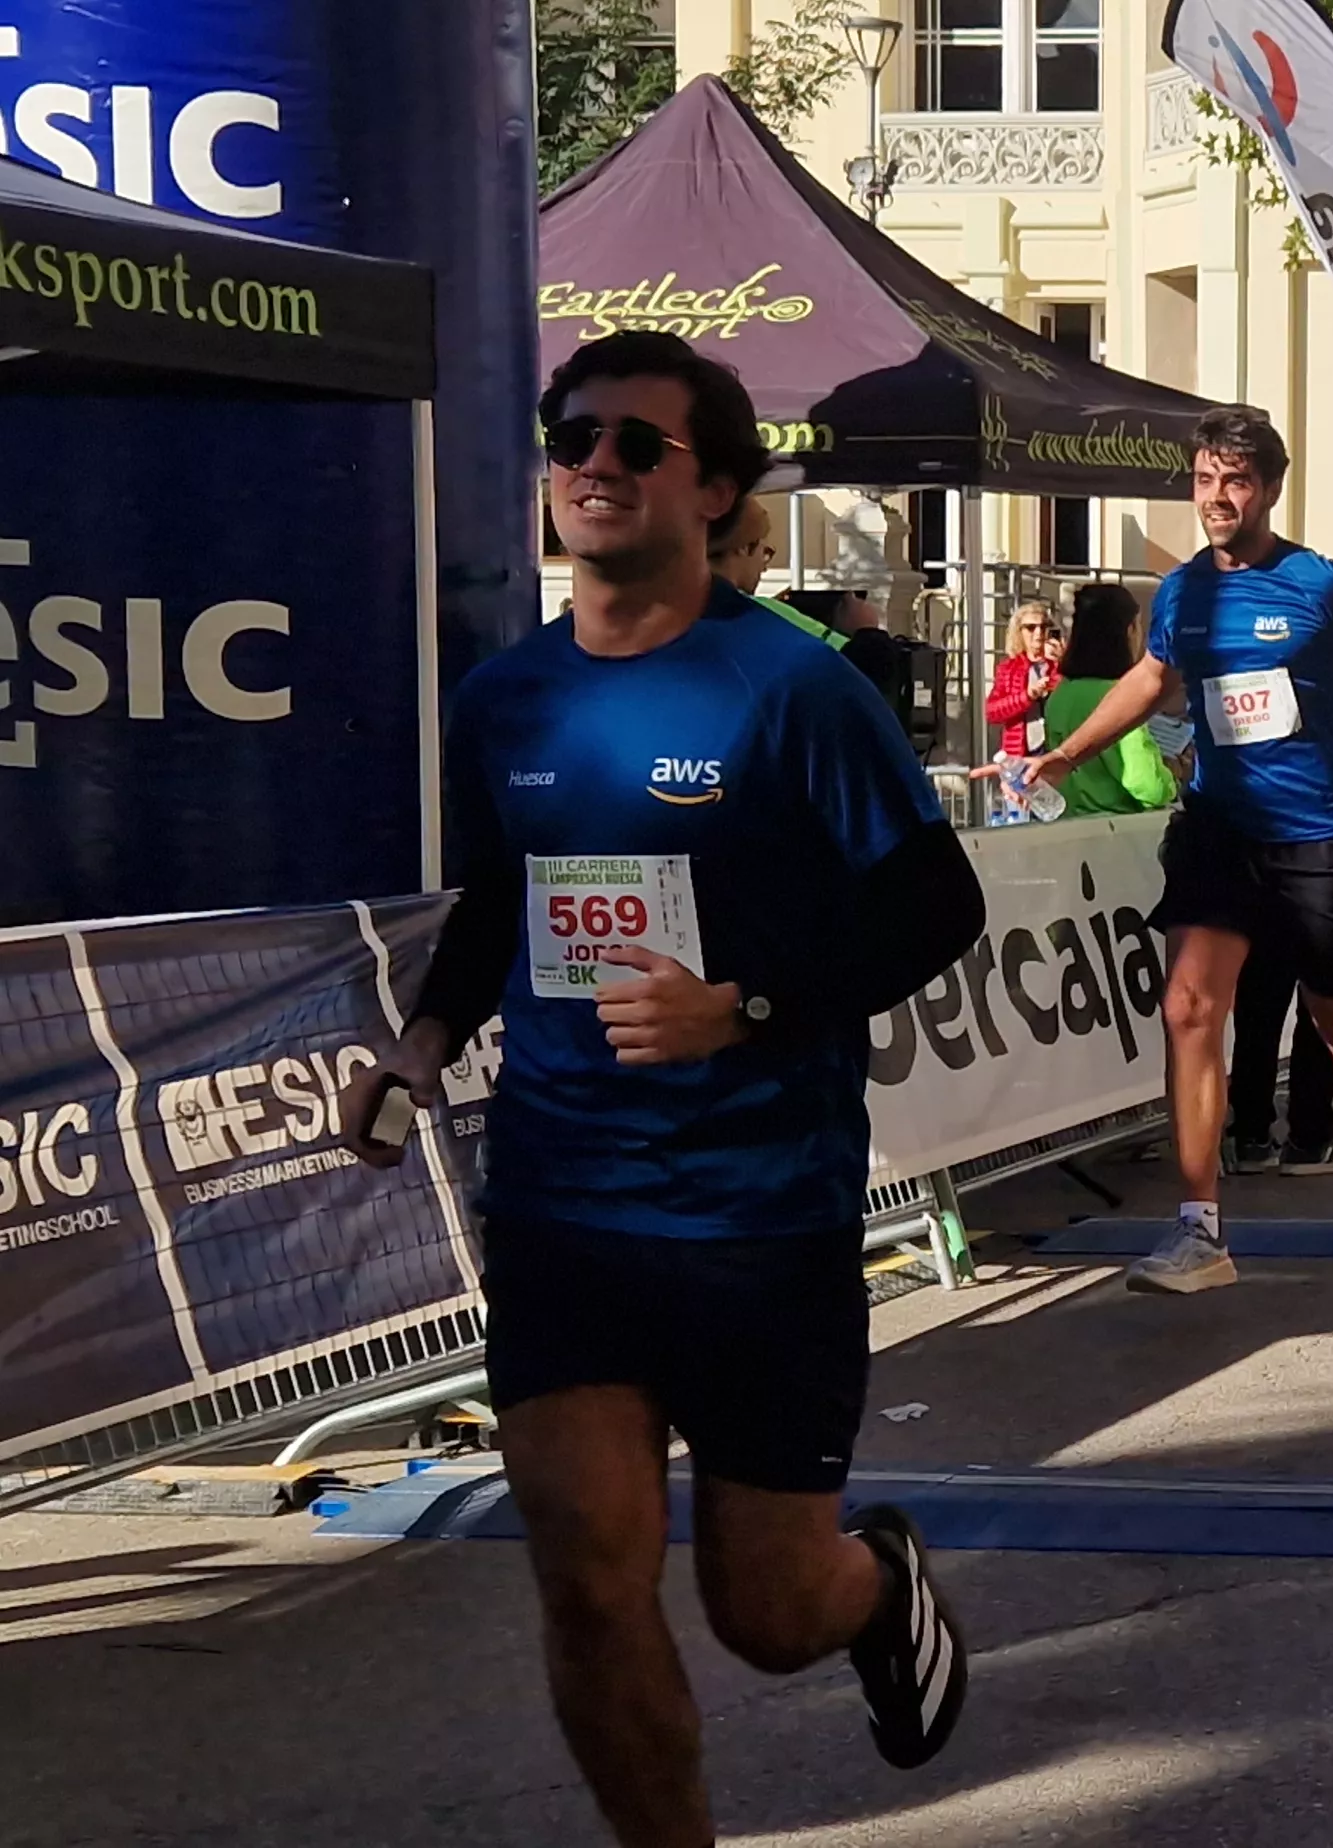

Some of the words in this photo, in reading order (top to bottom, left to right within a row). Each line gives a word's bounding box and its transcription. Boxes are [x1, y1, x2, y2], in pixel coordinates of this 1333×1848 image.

[0, 82, 283, 218] SIC
[1254, 616, 1288, 631] aws
[1223, 690, 1271, 715] 307
[1234, 713, 1271, 726] DIEGO
[508, 771, 555, 787] Huesca
[652, 757, 722, 785] aws
[566, 860, 642, 872] CARRERA
[548, 895, 647, 937] 569
[567, 965, 598, 985] 8K
